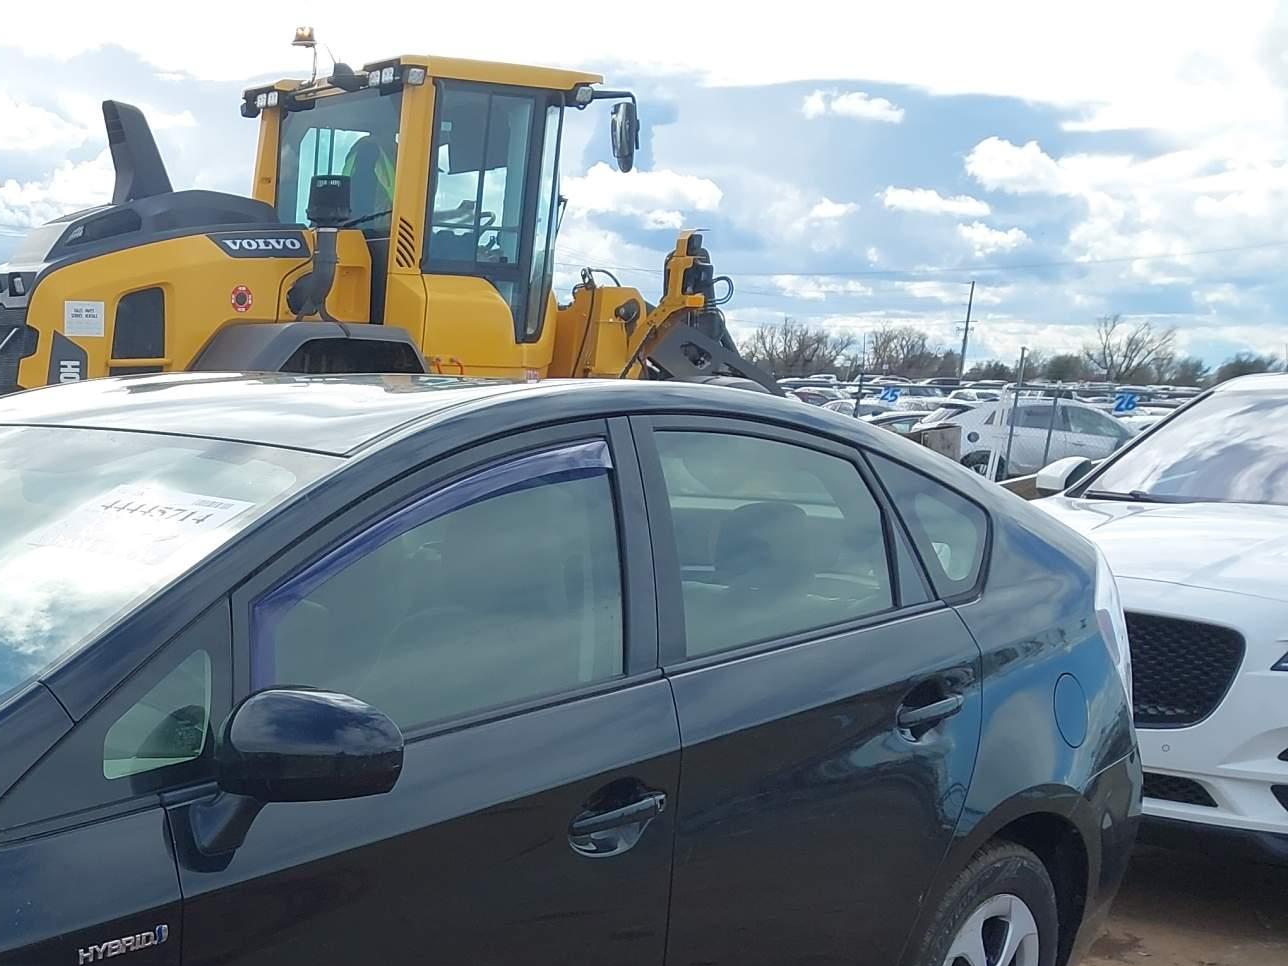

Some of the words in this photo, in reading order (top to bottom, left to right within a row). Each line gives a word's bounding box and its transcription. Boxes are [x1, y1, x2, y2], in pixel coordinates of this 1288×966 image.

[222, 238, 301, 250] VOLVO
[880, 388, 901, 403] 25
[1114, 394, 1137, 412] 26
[101, 499, 215, 525] 44445714
[78, 931, 156, 965] HYBRID
